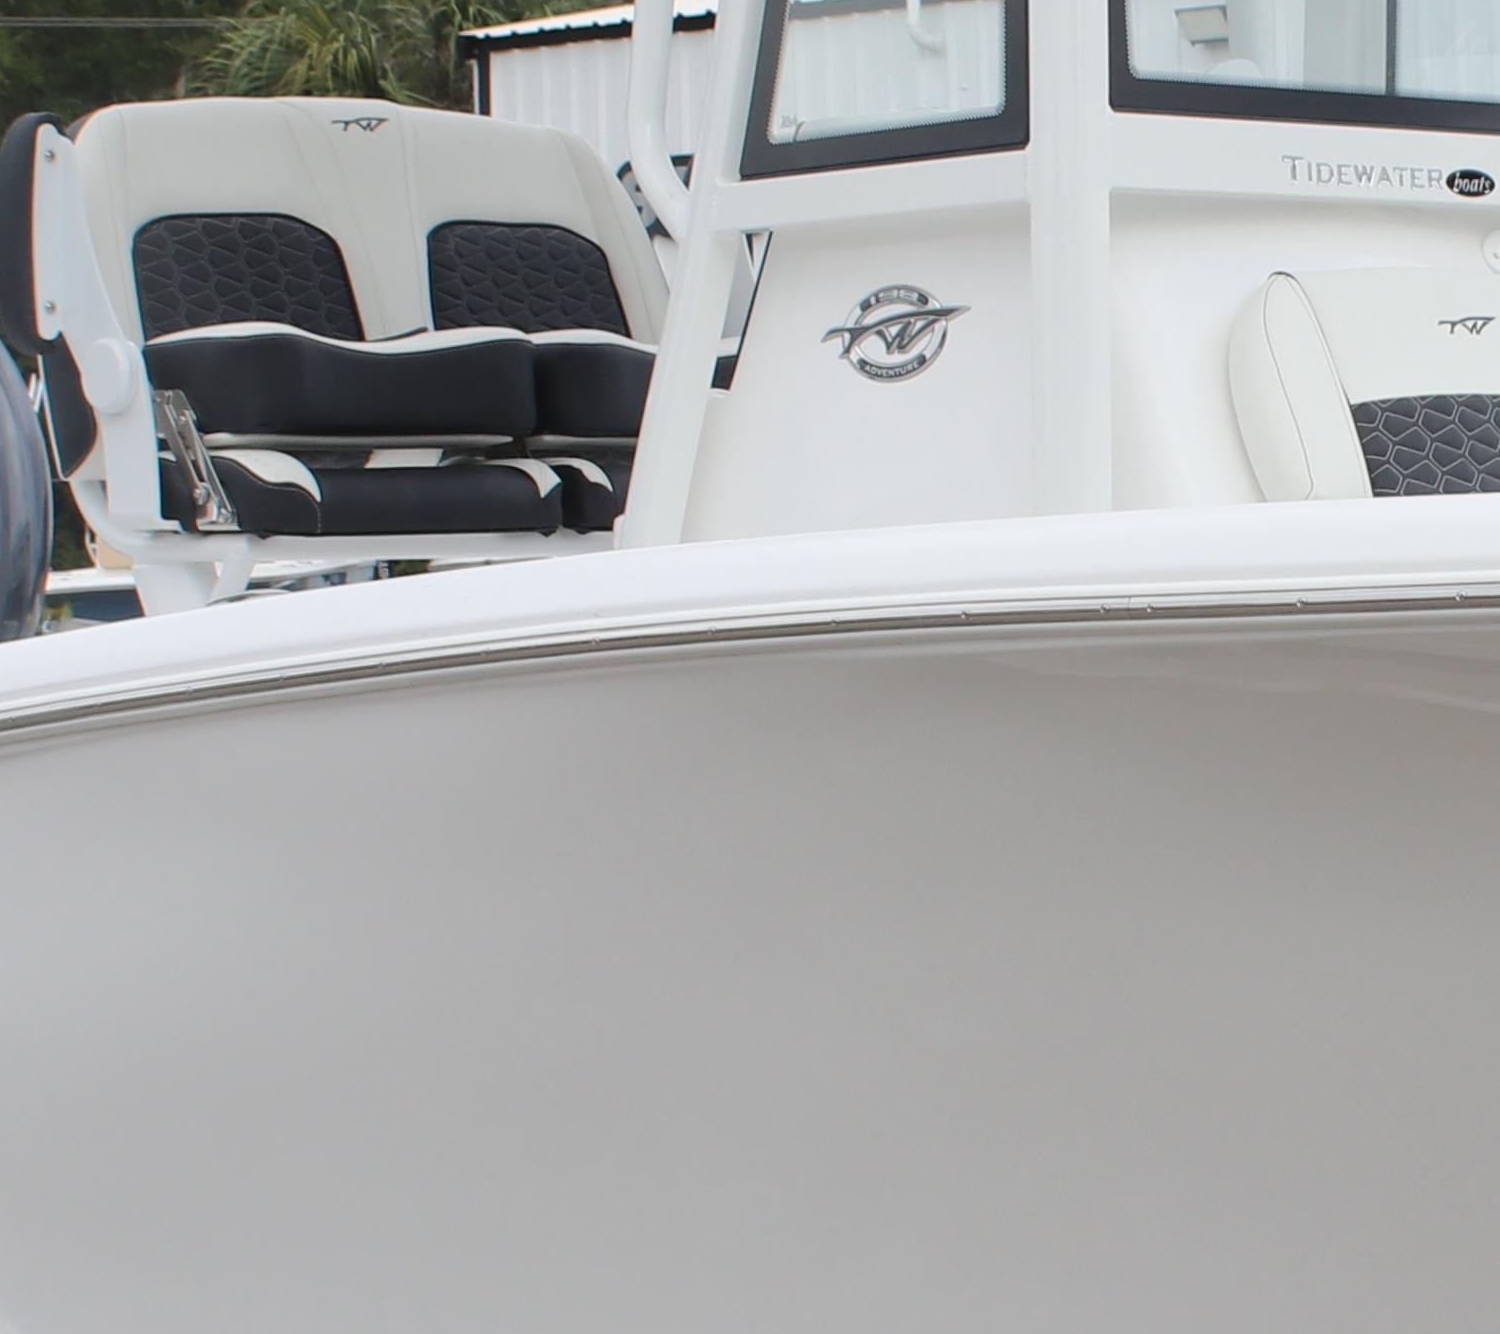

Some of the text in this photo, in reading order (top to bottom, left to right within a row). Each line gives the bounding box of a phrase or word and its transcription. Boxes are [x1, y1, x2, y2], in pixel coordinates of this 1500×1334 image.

[1281, 154, 1491, 195] TIDEWATER boats
[864, 360, 920, 378] ADVENTURE
